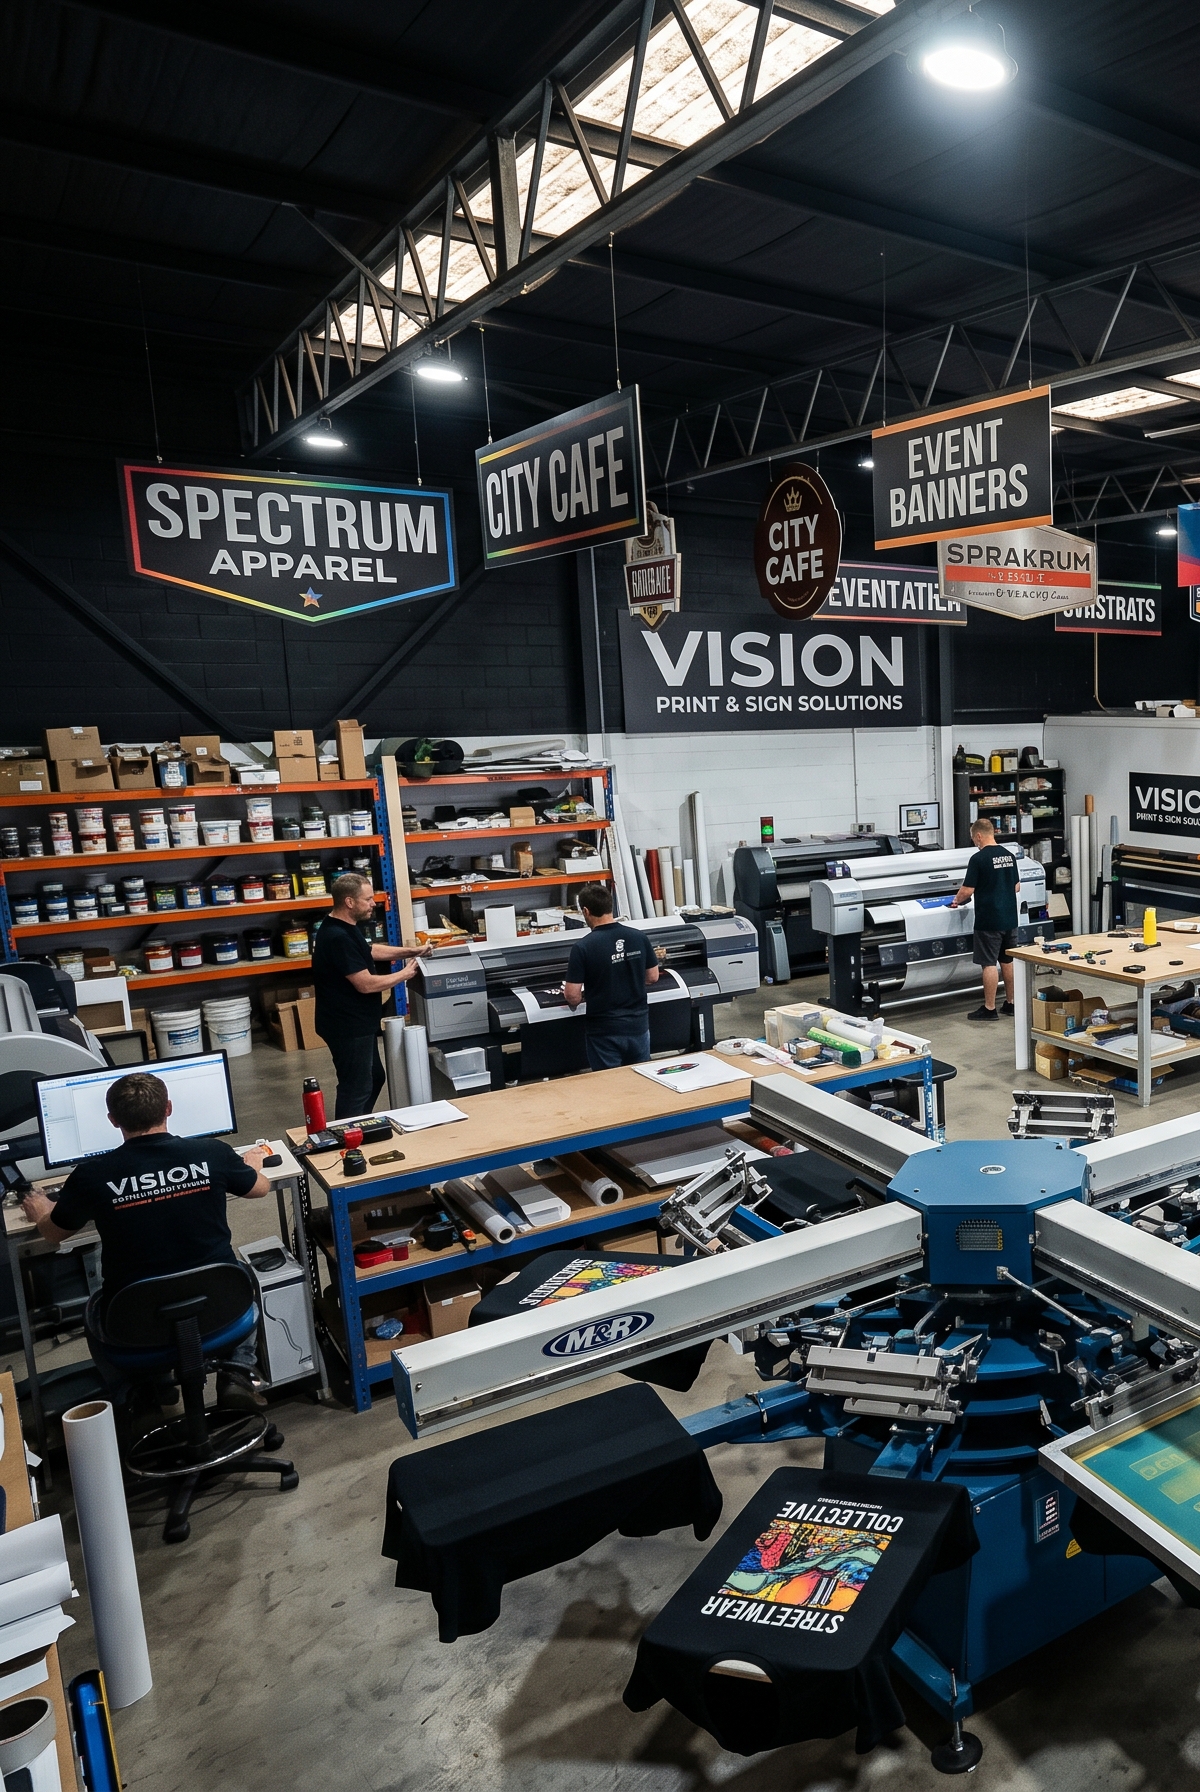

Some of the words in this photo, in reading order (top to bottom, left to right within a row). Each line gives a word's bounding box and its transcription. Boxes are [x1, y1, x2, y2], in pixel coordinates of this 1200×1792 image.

[907, 419, 1003, 479] EVENT
[486, 457, 541, 539] CITY
[548, 426, 628, 523] CAFE
[890, 464, 1029, 528] BANNERS
[145, 482, 438, 554] SPECTRUM
[768, 516, 818, 552] CITY
[208, 549, 397, 584] APPAREL
[766, 549, 823, 586] CAFE
[947, 543, 1090, 571] SPRAKRUM
[642, 630, 904, 688] VISION
[656, 696, 720, 713] PRINT
[725, 696, 741, 713] &
[745, 696, 793, 712] SIGN
[798, 694, 903, 711] SOLUTIONS
[106, 1161, 210, 1196] VISION
[564, 1315, 634, 1353] M&R
[776, 1501, 904, 1533] COLLECTIVE
[700, 1595, 845, 1634] STREETWEAR
